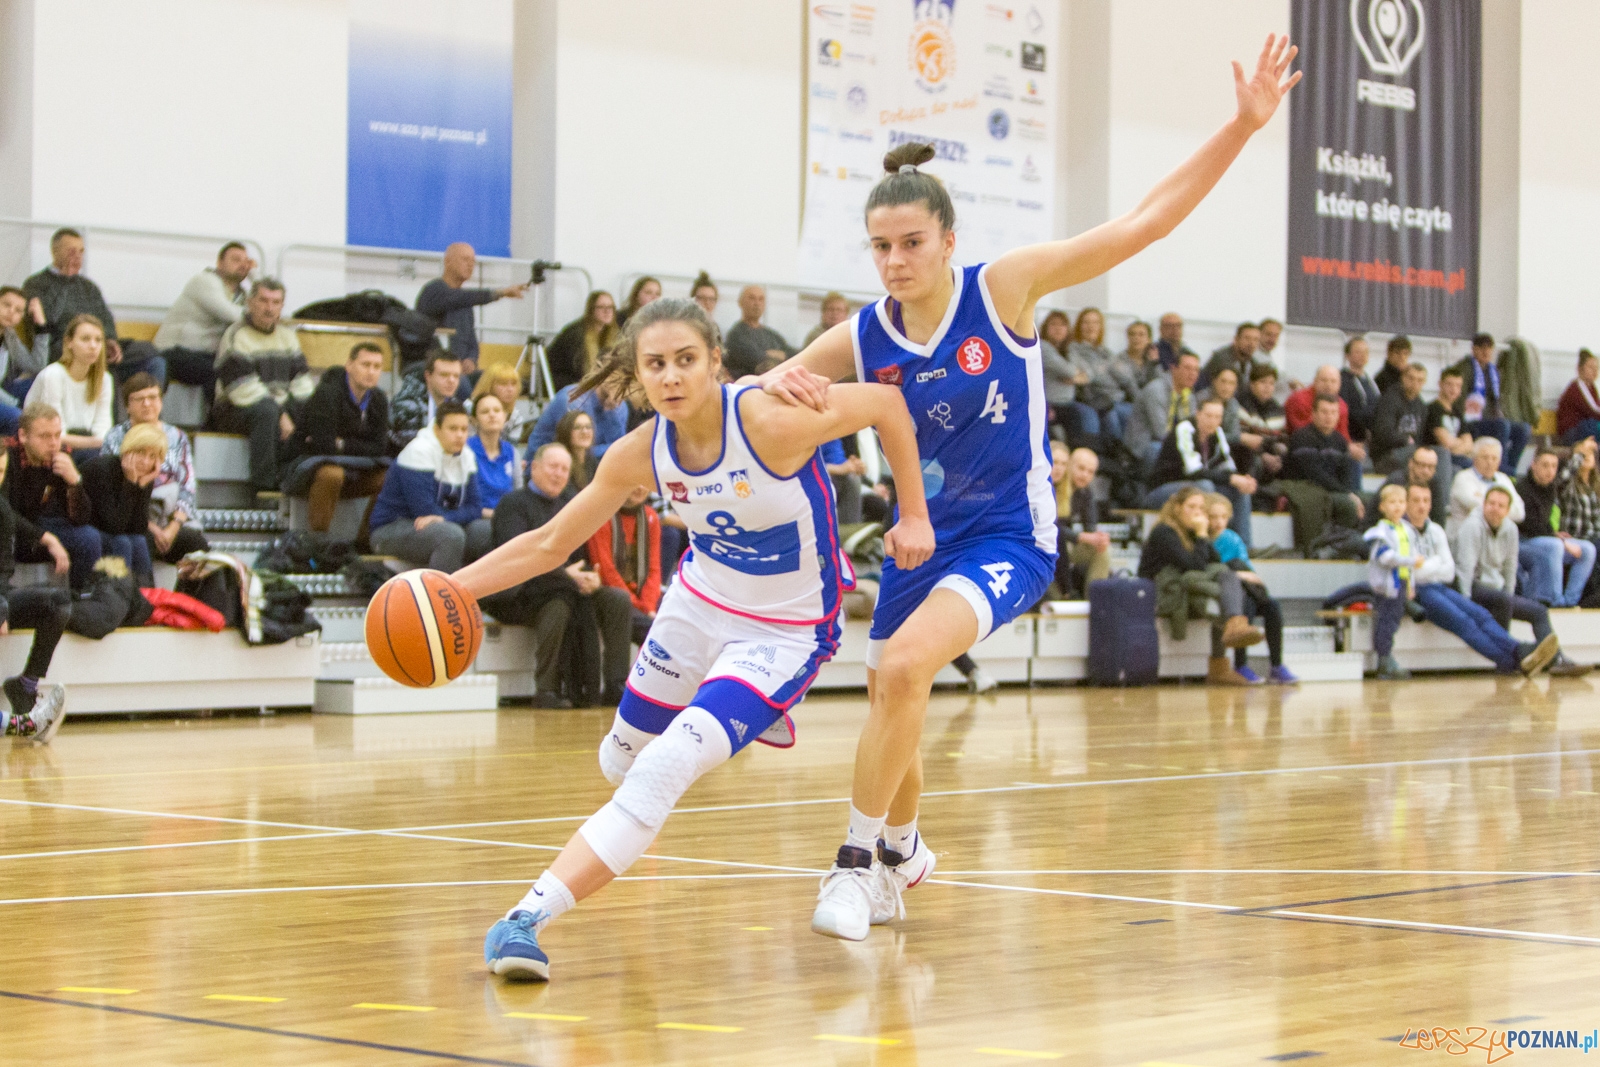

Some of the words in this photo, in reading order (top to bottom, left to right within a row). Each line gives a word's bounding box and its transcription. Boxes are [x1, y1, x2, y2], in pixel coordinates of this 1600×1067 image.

[1357, 79, 1416, 110] REBIS
[1316, 147, 1392, 185] Książki,
[1316, 190, 1369, 220] które
[1371, 198, 1402, 230] się
[1402, 206, 1452, 235] czyta
[1302, 255, 1466, 295] www.rebis.com.pl
[979, 379, 1008, 424] 4
[706, 510, 744, 537] 8
[980, 561, 1015, 599] 4
[438, 588, 465, 655] molten
[649, 641, 668, 659] Ford
[649, 659, 680, 679] Motors
